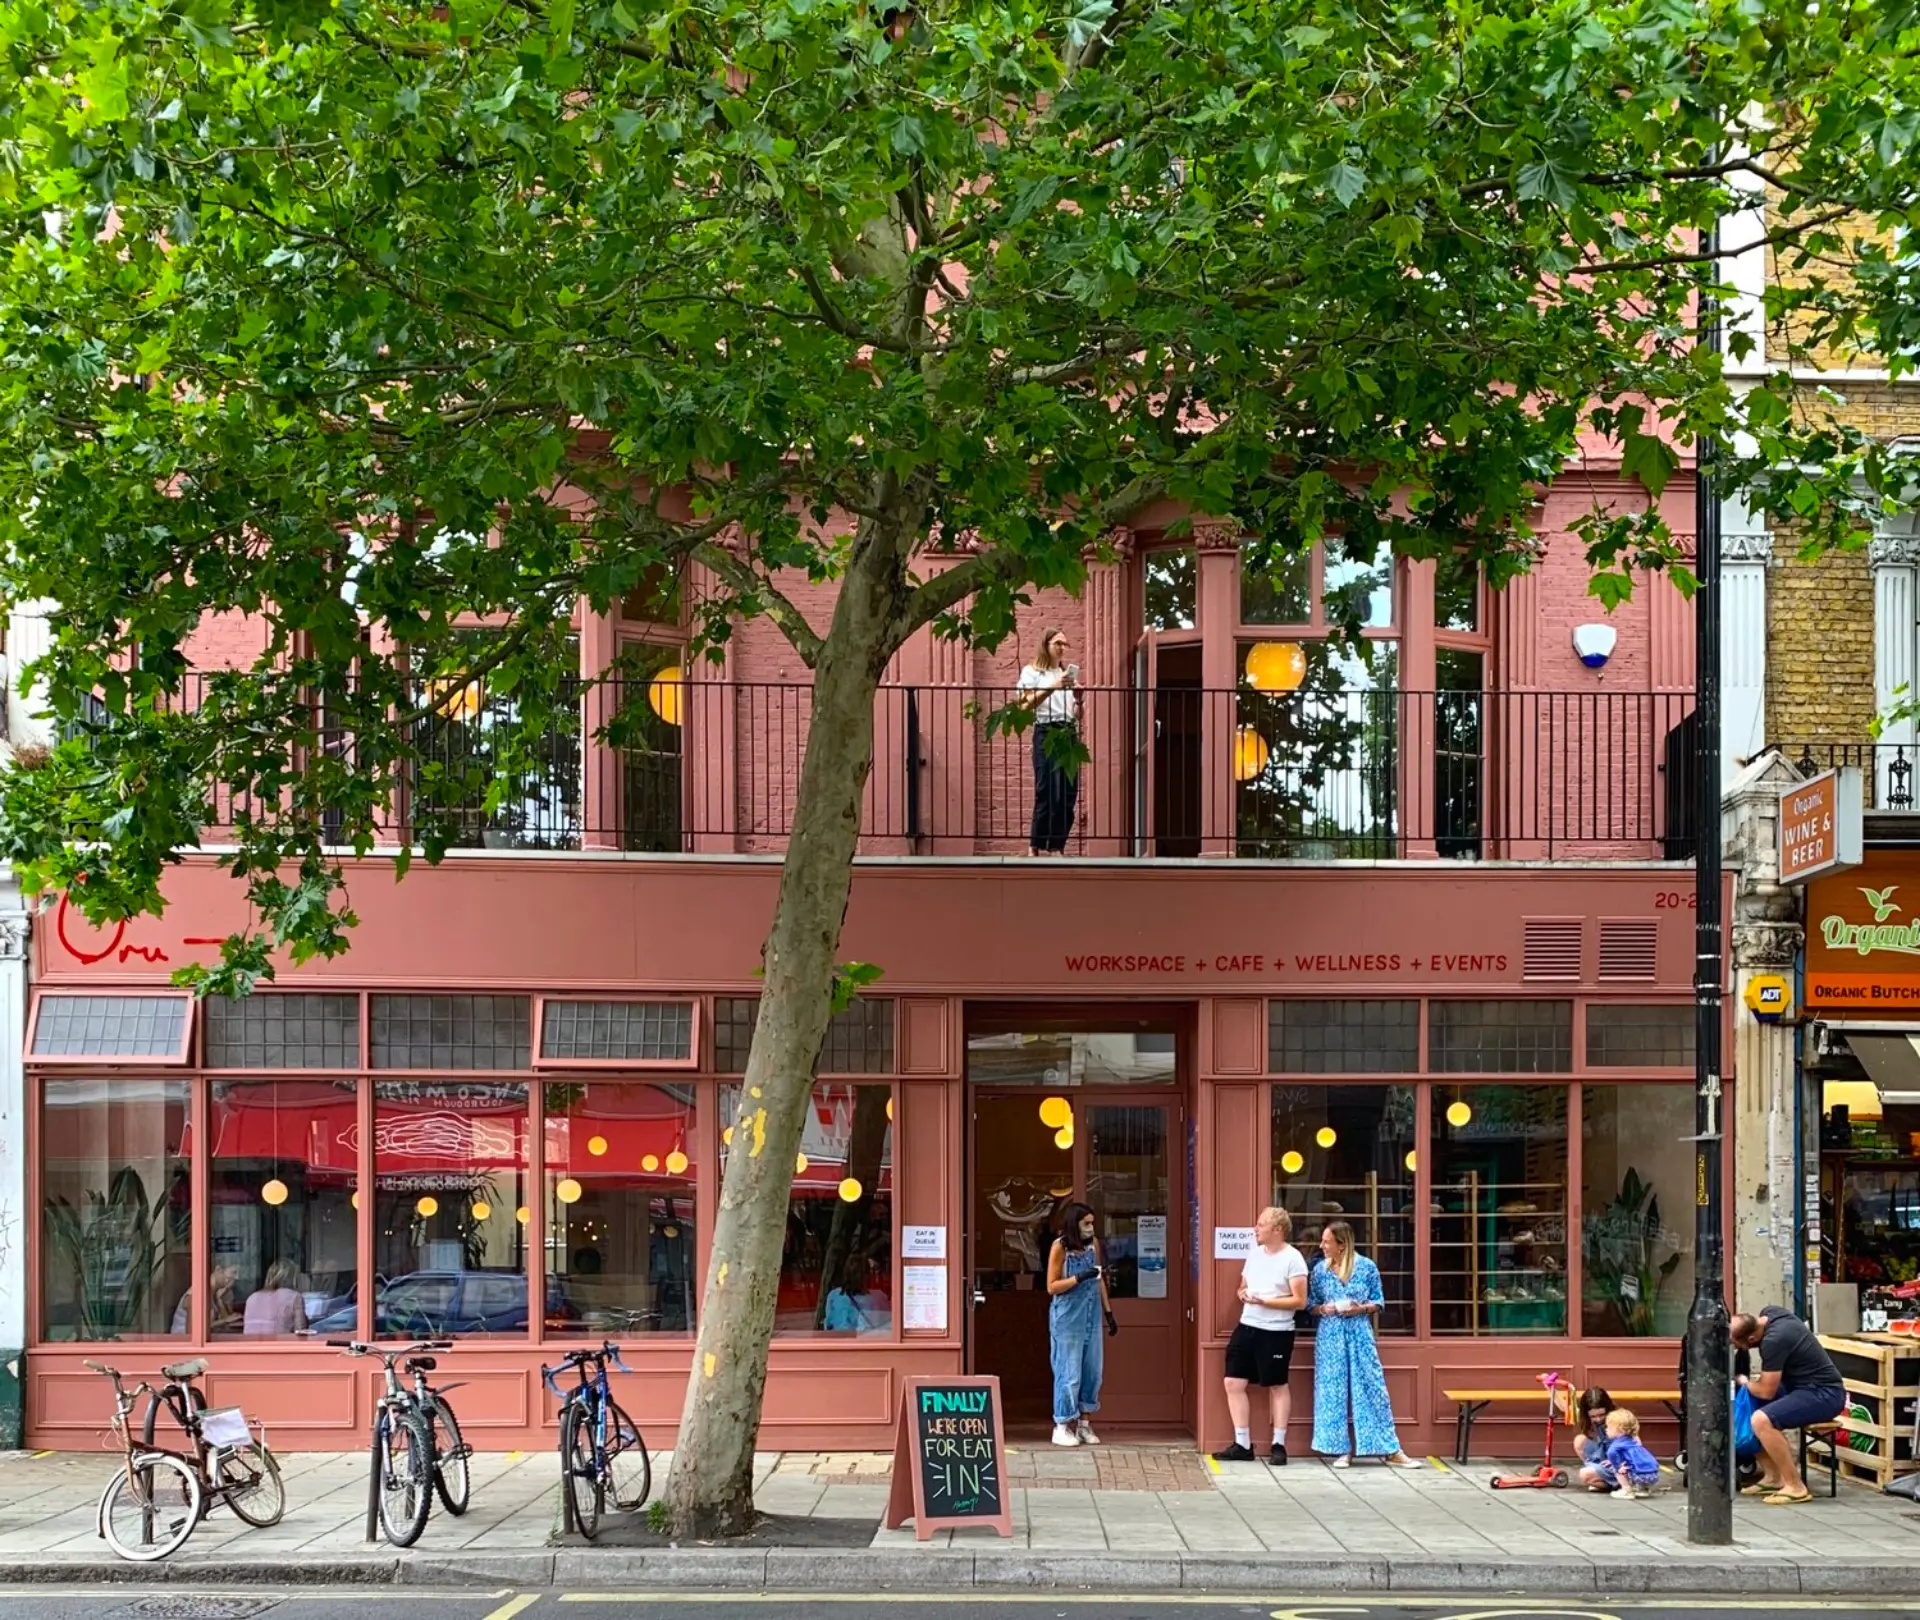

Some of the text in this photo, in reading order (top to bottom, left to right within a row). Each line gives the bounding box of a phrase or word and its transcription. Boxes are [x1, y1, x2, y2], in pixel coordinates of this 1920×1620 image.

[1794, 788, 1823, 816] Organic
[1785, 812, 1831, 847] WINE &
[1792, 838, 1823, 867] BEER
[1065, 955, 1186, 972] WORKSPACE
[1215, 955, 1264, 972] CAFE
[1295, 955, 1401, 971] WELLNESS
[1430, 955, 1508, 971] EVENTS
[1761, 988, 1781, 1000] ADT
[1221, 1242, 1251, 1250] QUEUE
[922, 1391, 988, 1413] FINALLY
[959, 1417, 988, 1435] OPEN
[924, 1437, 993, 1459] FOR EAT
[945, 1463, 980, 1496] IN
